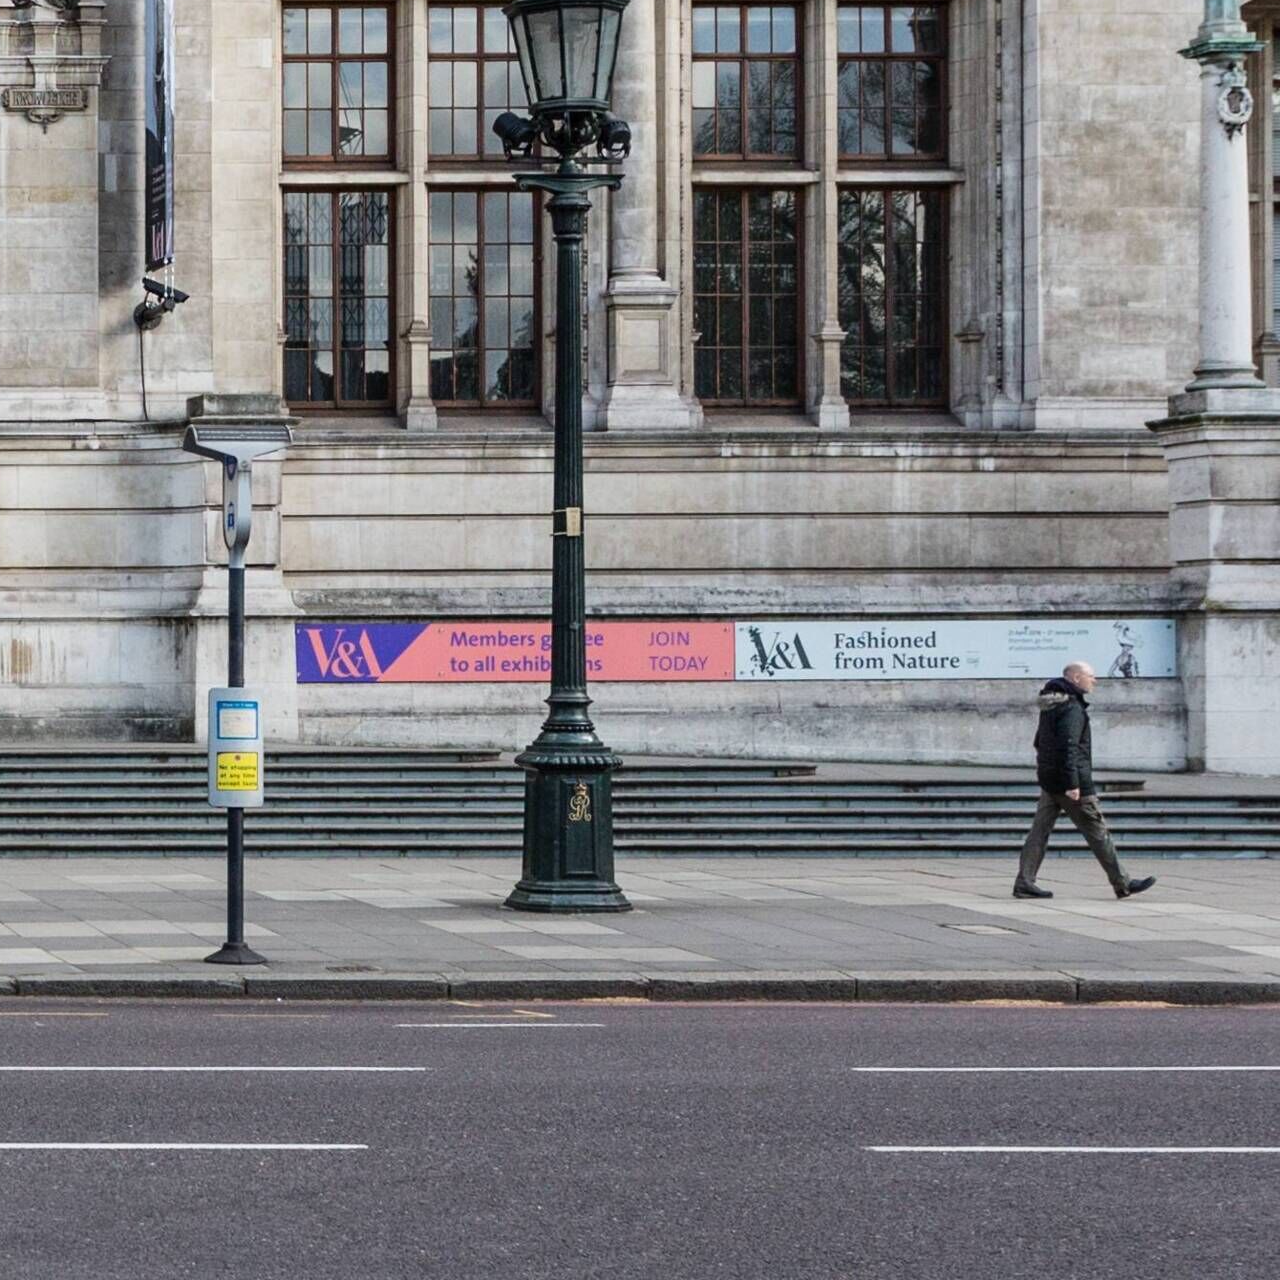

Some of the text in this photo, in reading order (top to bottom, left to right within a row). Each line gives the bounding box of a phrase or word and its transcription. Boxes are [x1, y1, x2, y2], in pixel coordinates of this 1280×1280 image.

[450, 631, 604, 651] Members g ee
[649, 631, 690, 647] JOIN
[834, 631, 937, 649] Fashioned
[304, 628, 384, 678] V&A
[751, 628, 814, 675] V&A
[451, 656, 603, 672] to all exhibns
[649, 656, 708, 671] TODAY
[835, 653, 884, 669] from
[893, 653, 960, 669] Nature
